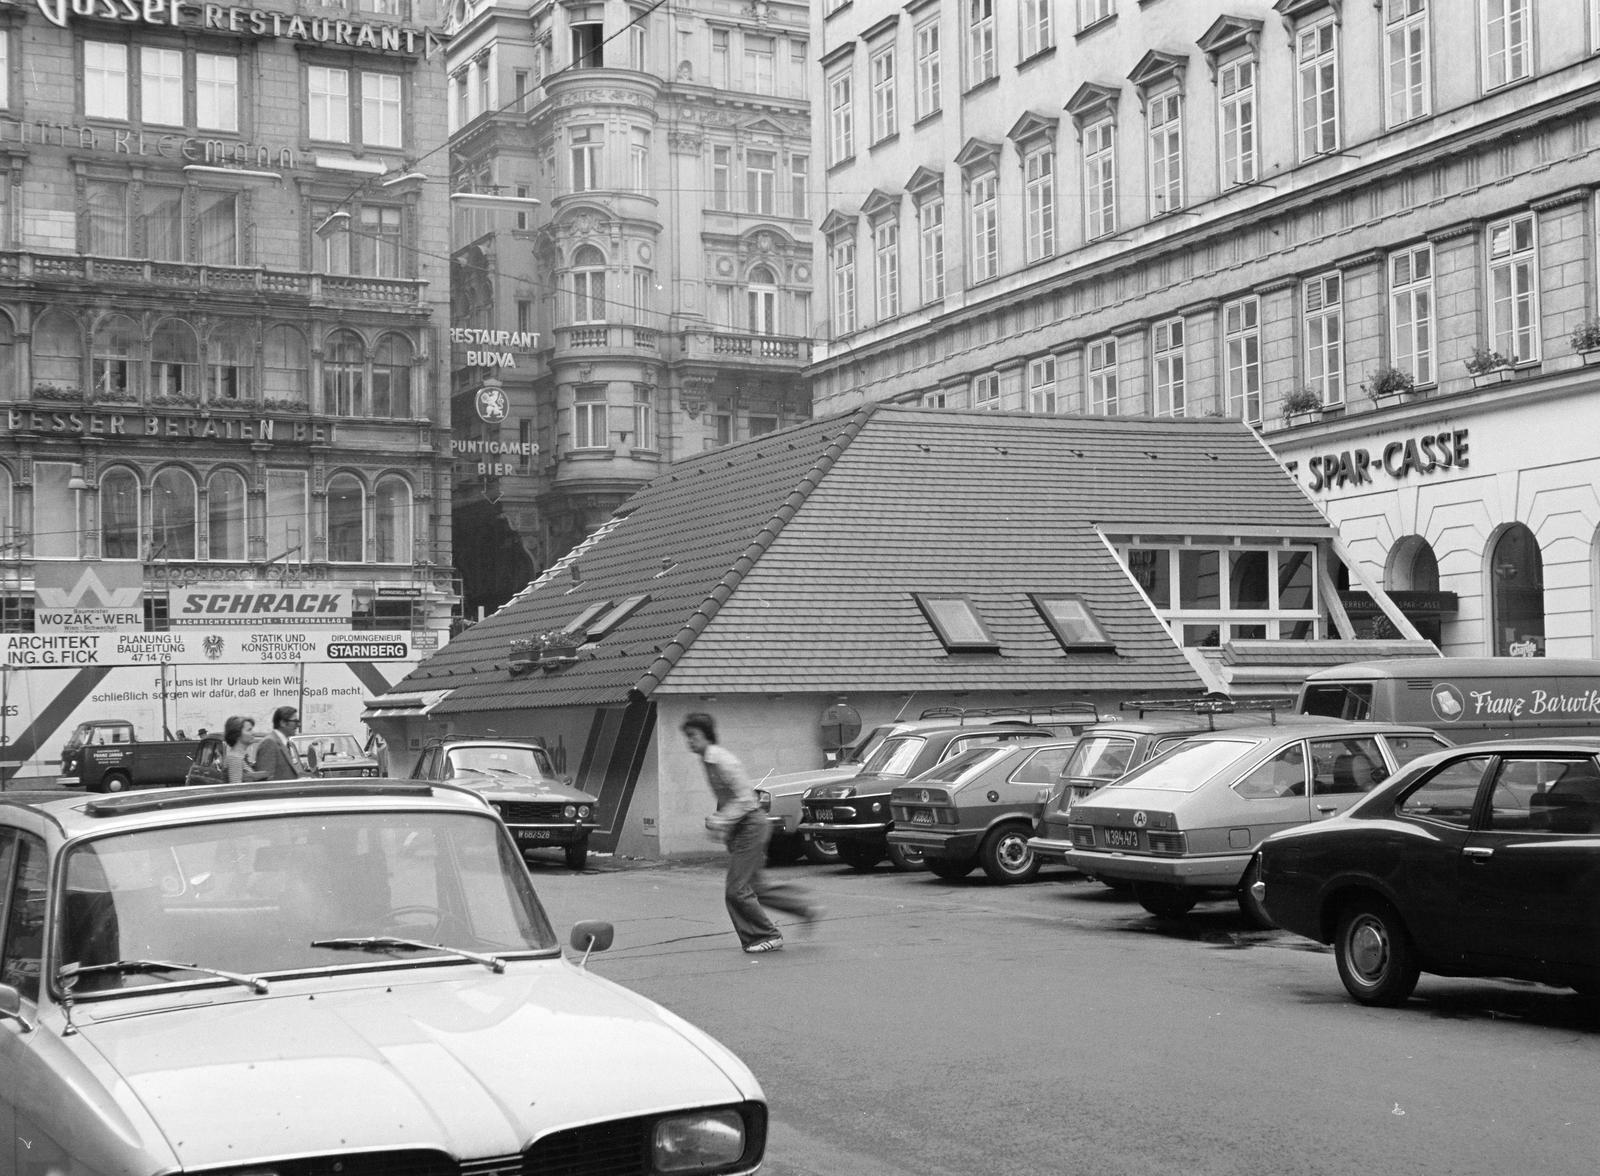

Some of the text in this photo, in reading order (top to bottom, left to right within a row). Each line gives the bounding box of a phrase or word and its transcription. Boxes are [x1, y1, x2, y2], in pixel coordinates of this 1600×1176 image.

[206, 3, 417, 53] RESTAURANT
[450, 328, 540, 348] RESTAURANT
[467, 351, 516, 369] BUDVA
[8, 409, 337, 442] BESSER BERATEN BEI
[450, 440, 540, 456] PUNTIGAMER
[1309, 428, 1469, 491] SPAR-CASSE
[477, 463, 513, 476] BIER
[182, 594, 342, 613] SCHRACK
[40, 614, 93, 625] WOZAK
[103, 613, 142, 625] WERL
[8, 636, 100, 649] ARCHITEKT
[120, 635, 183, 644] PLANUNG U.
[251, 634, 306, 643] STATIK UND
[331, 634, 402, 642] DIPLOMINGENIEUR
[117, 644, 185, 653] BAULEITUNG
[241, 642, 316, 652] KONSTRUKTION
[329, 644, 405, 657] STARNBERG
[7, 650, 98, 664] ING. G. FICK
[131, 653, 171, 662] 47 14 76
[261, 651, 301, 660] 34 03 84
[154, 678, 173, 687] Fr
[195, 677, 208, 686] ist
[210, 677, 223, 686] Ihr
[227, 676, 259, 687] Urlaub
[261, 676, 281, 686] kein
[91, 691, 149, 703] schließlich
[152, 691, 189, 701] sorgen
[191, 689, 206, 698] wir
[208, 688, 237, 699] dafür,
[238, 688, 257, 698] daß
[260, 689, 269, 697] er
[273, 688, 299, 697] Ihnen
[303, 687, 329, 698] Spaß
[1469, 689, 1600, 717] Franz Barwik
